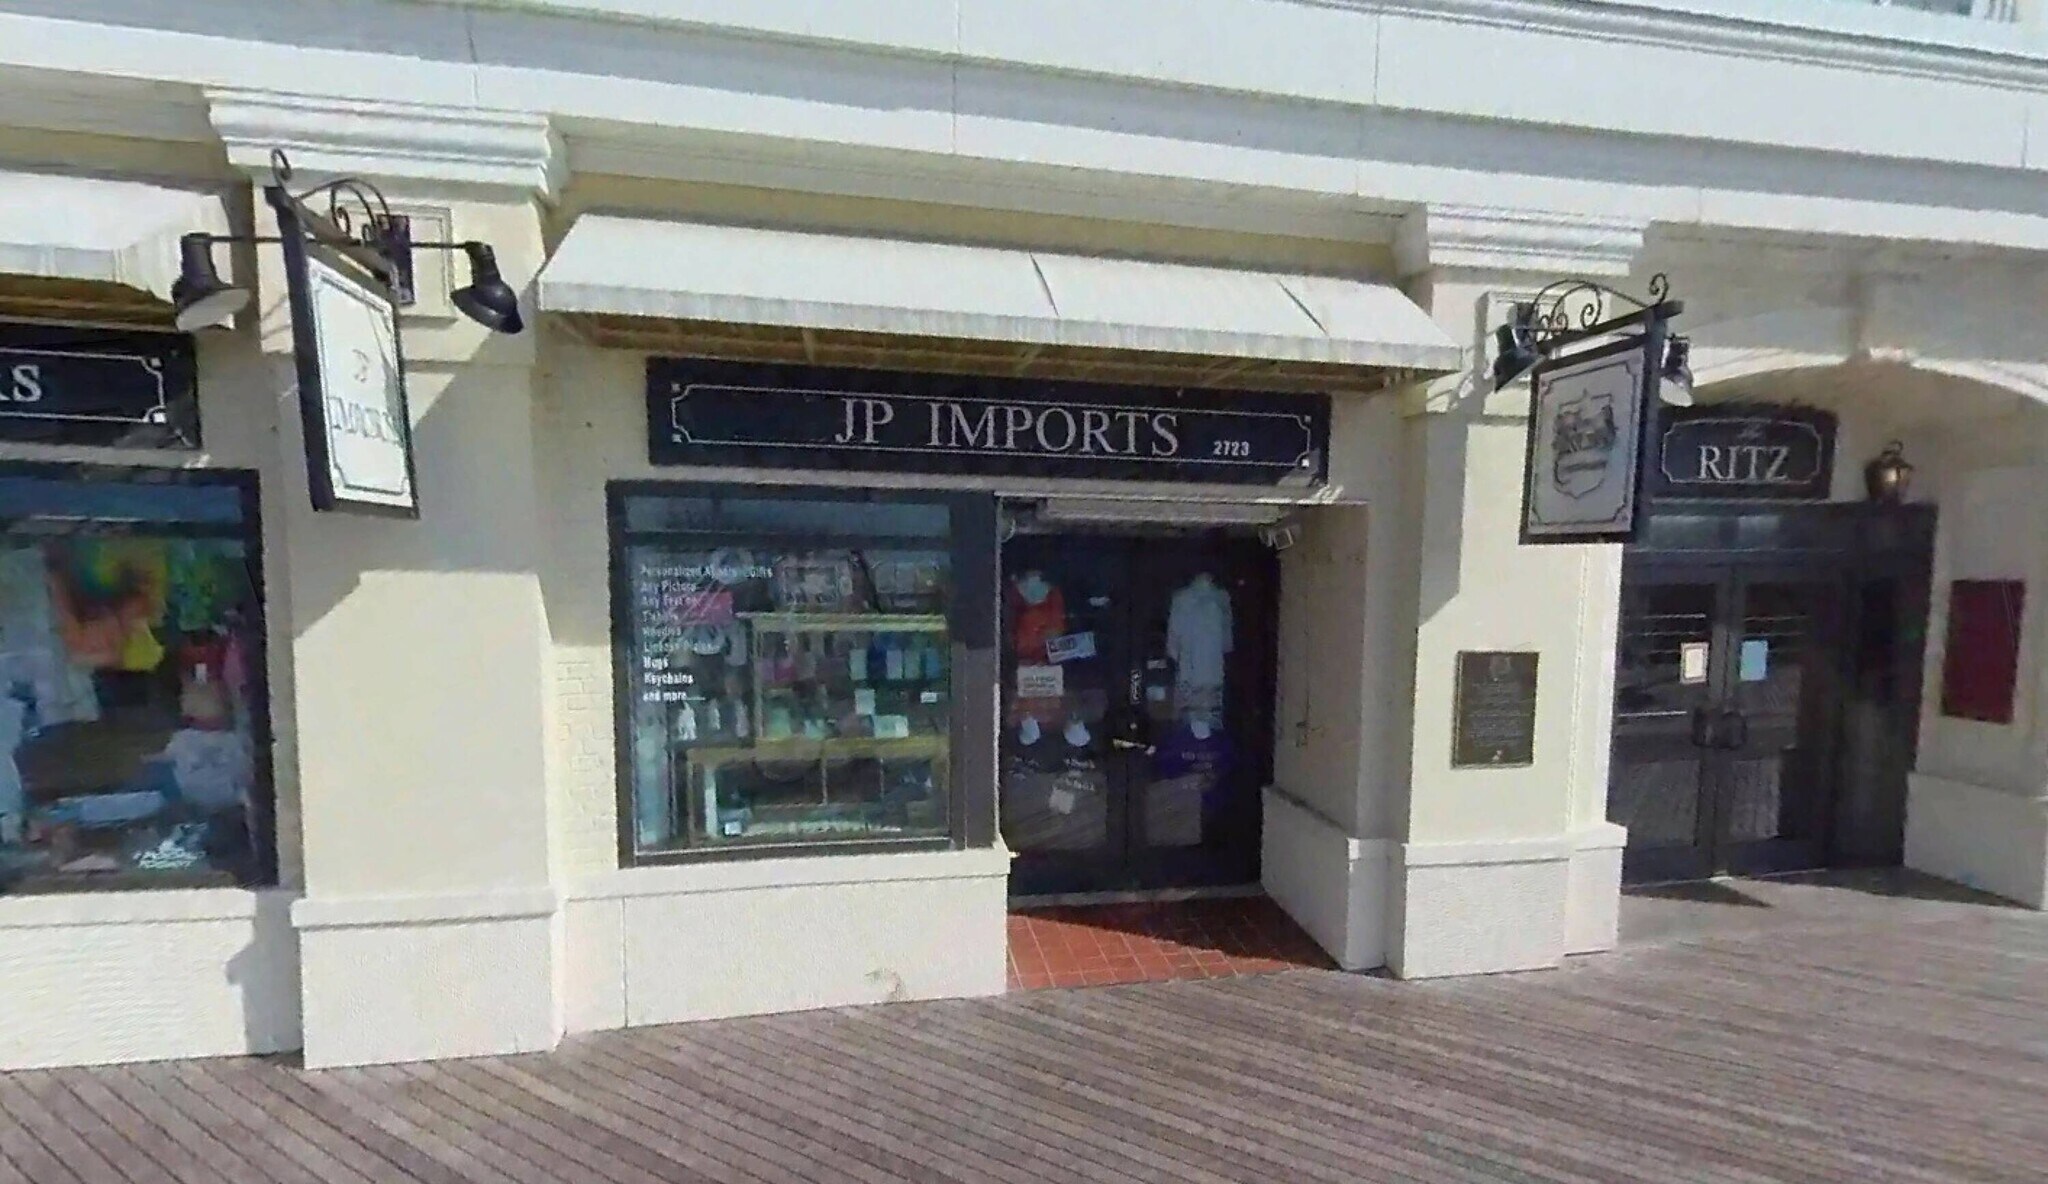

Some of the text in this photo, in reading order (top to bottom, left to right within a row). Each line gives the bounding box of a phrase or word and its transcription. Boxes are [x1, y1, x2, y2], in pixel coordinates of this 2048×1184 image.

[0, 364, 42, 402] S
[834, 397, 1250, 457] JP IMPORTS 2723
[1697, 444, 1790, 481] RITZ
[642, 655, 669, 670] Mugs
[644, 671, 694, 687] Keychains
